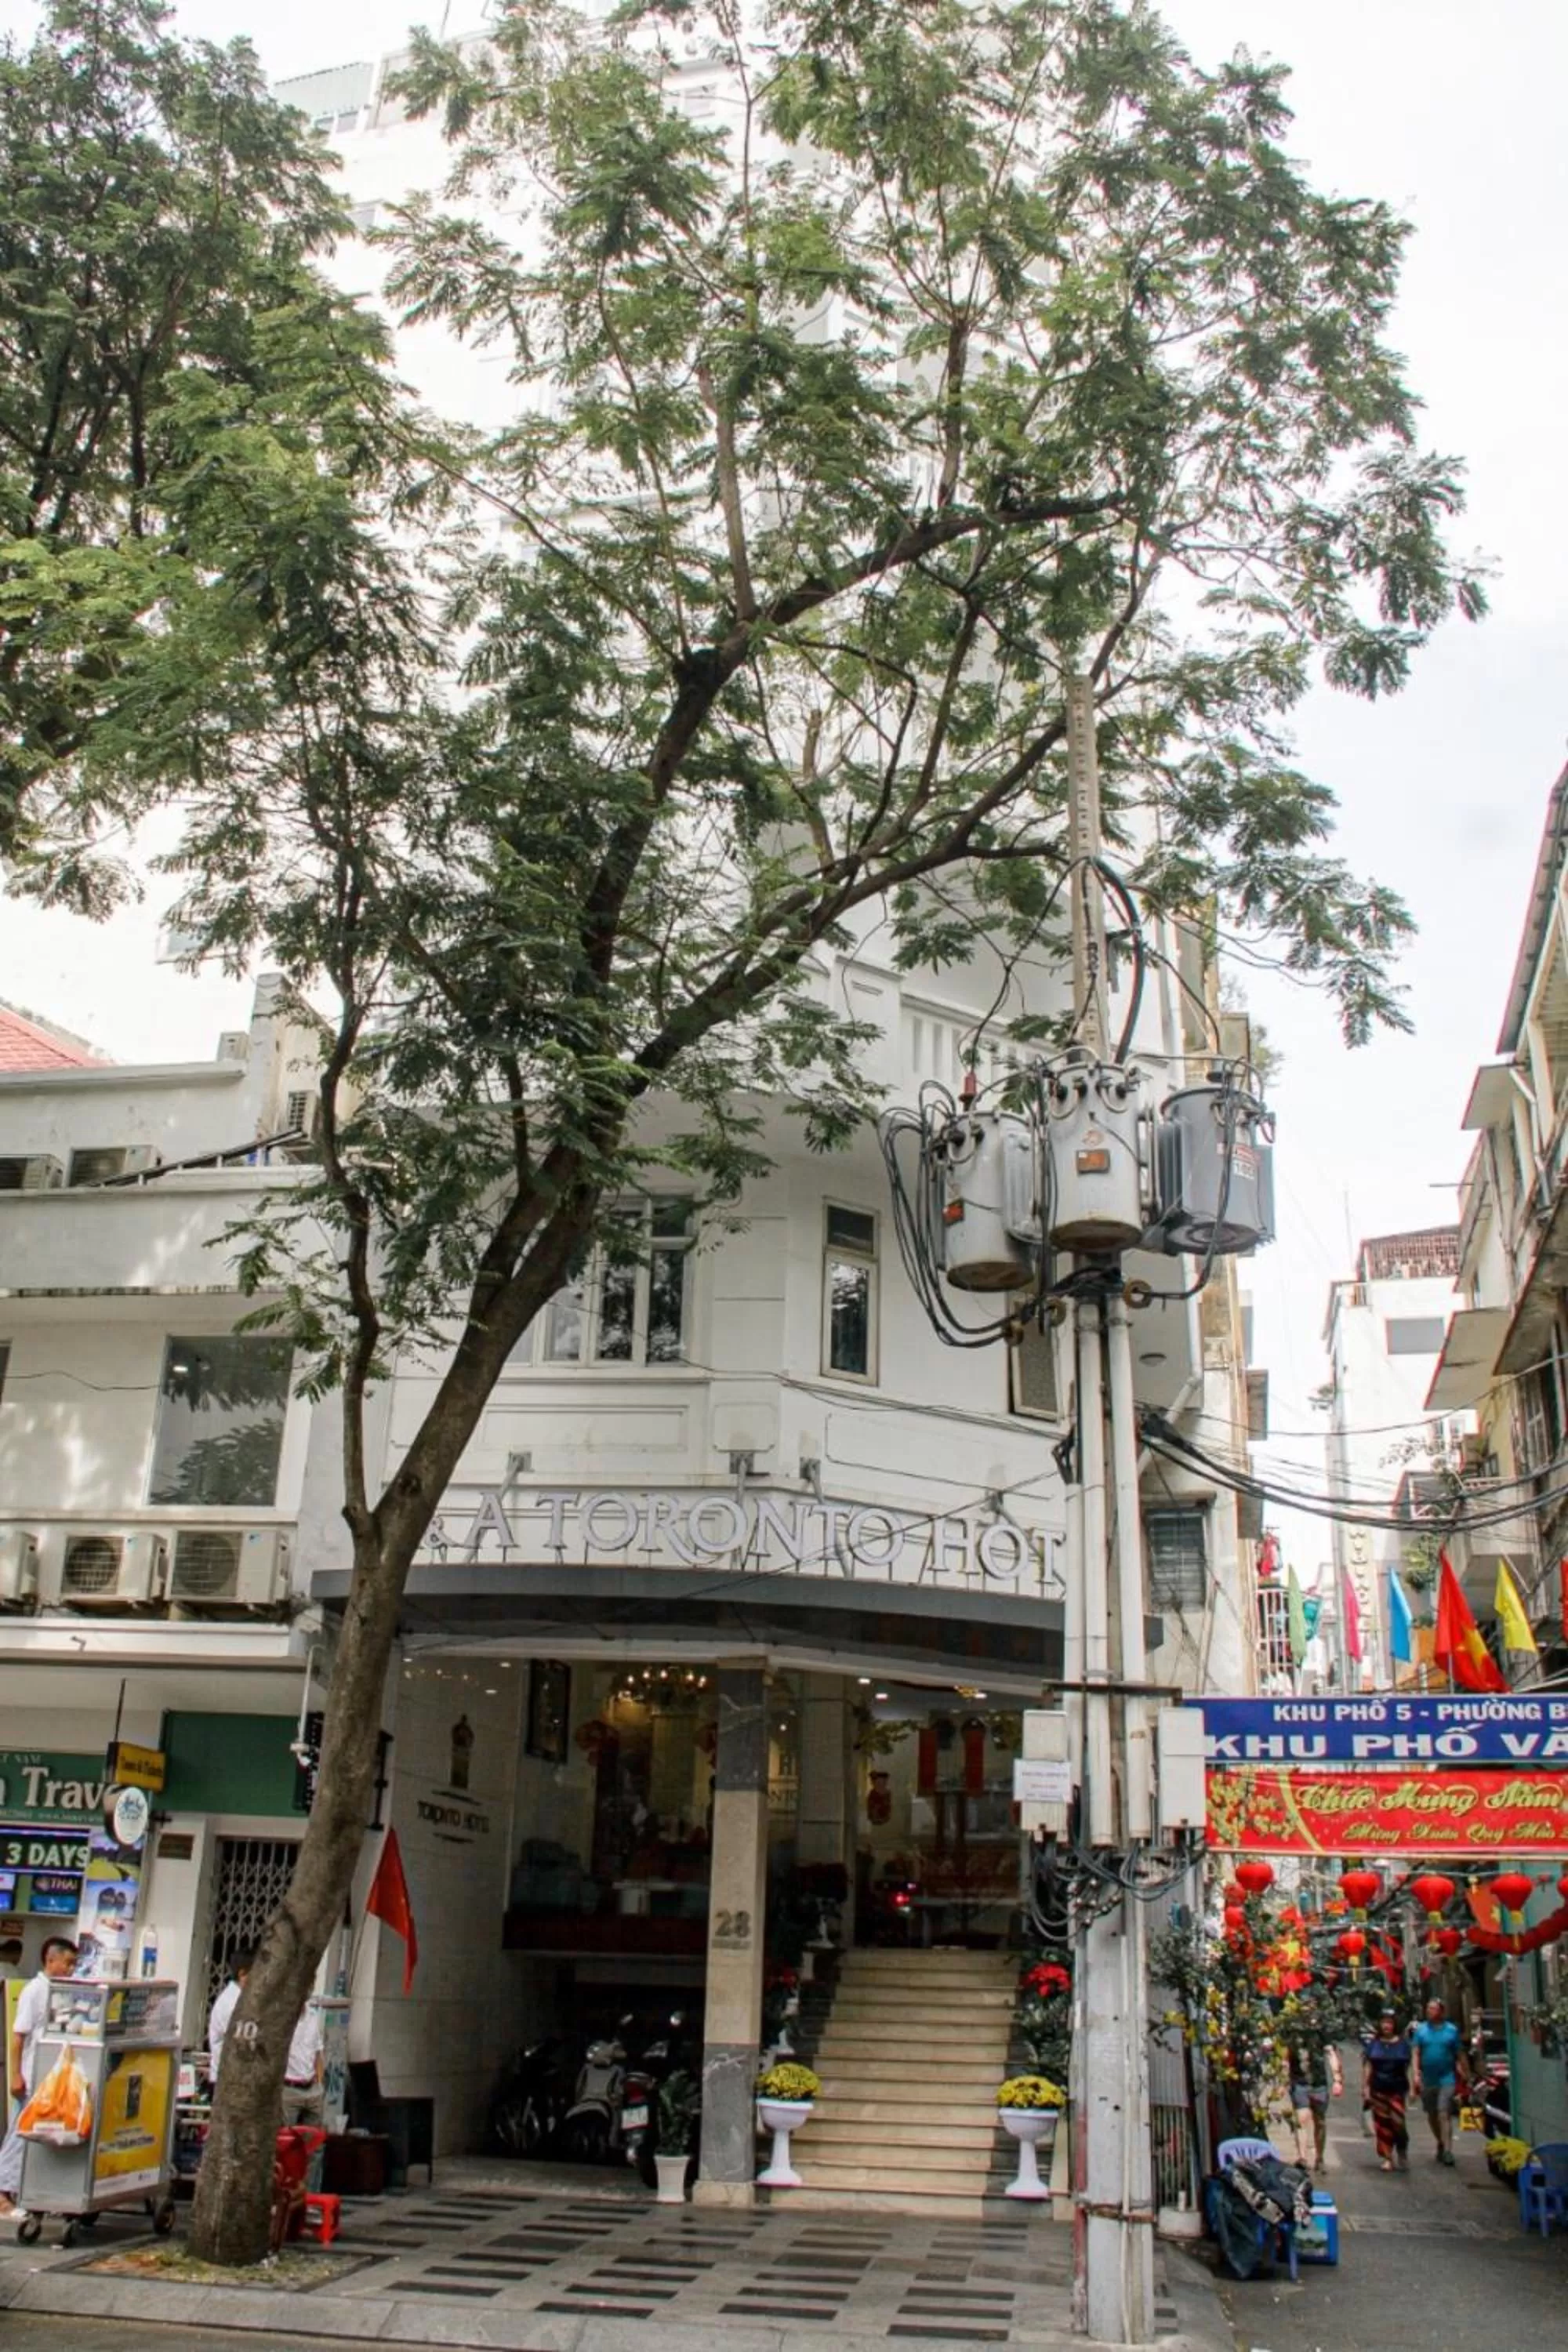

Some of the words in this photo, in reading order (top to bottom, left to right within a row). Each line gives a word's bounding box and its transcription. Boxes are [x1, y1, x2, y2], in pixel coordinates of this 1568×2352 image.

[535, 1492, 906, 1566] TORONTO
[1273, 1704, 1327, 1722] KHU
[1334, 1698, 1388, 1722] PHỐ
[1396, 1704, 1412, 1722] 5
[1436, 1696, 1543, 1721] PHƯỜNG
[1548, 1703, 1568, 1721] B
[1203, 1733, 1327, 1758] KHU
[1352, 1722, 1484, 1758] PHỐ
[1378, 1780, 1479, 1817] Mừng
[1483, 1779, 1564, 1809] Năm
[5, 1842, 23, 1865] 3
[28, 1843, 89, 1868] DAYS
[234, 2020, 259, 2040] 10
